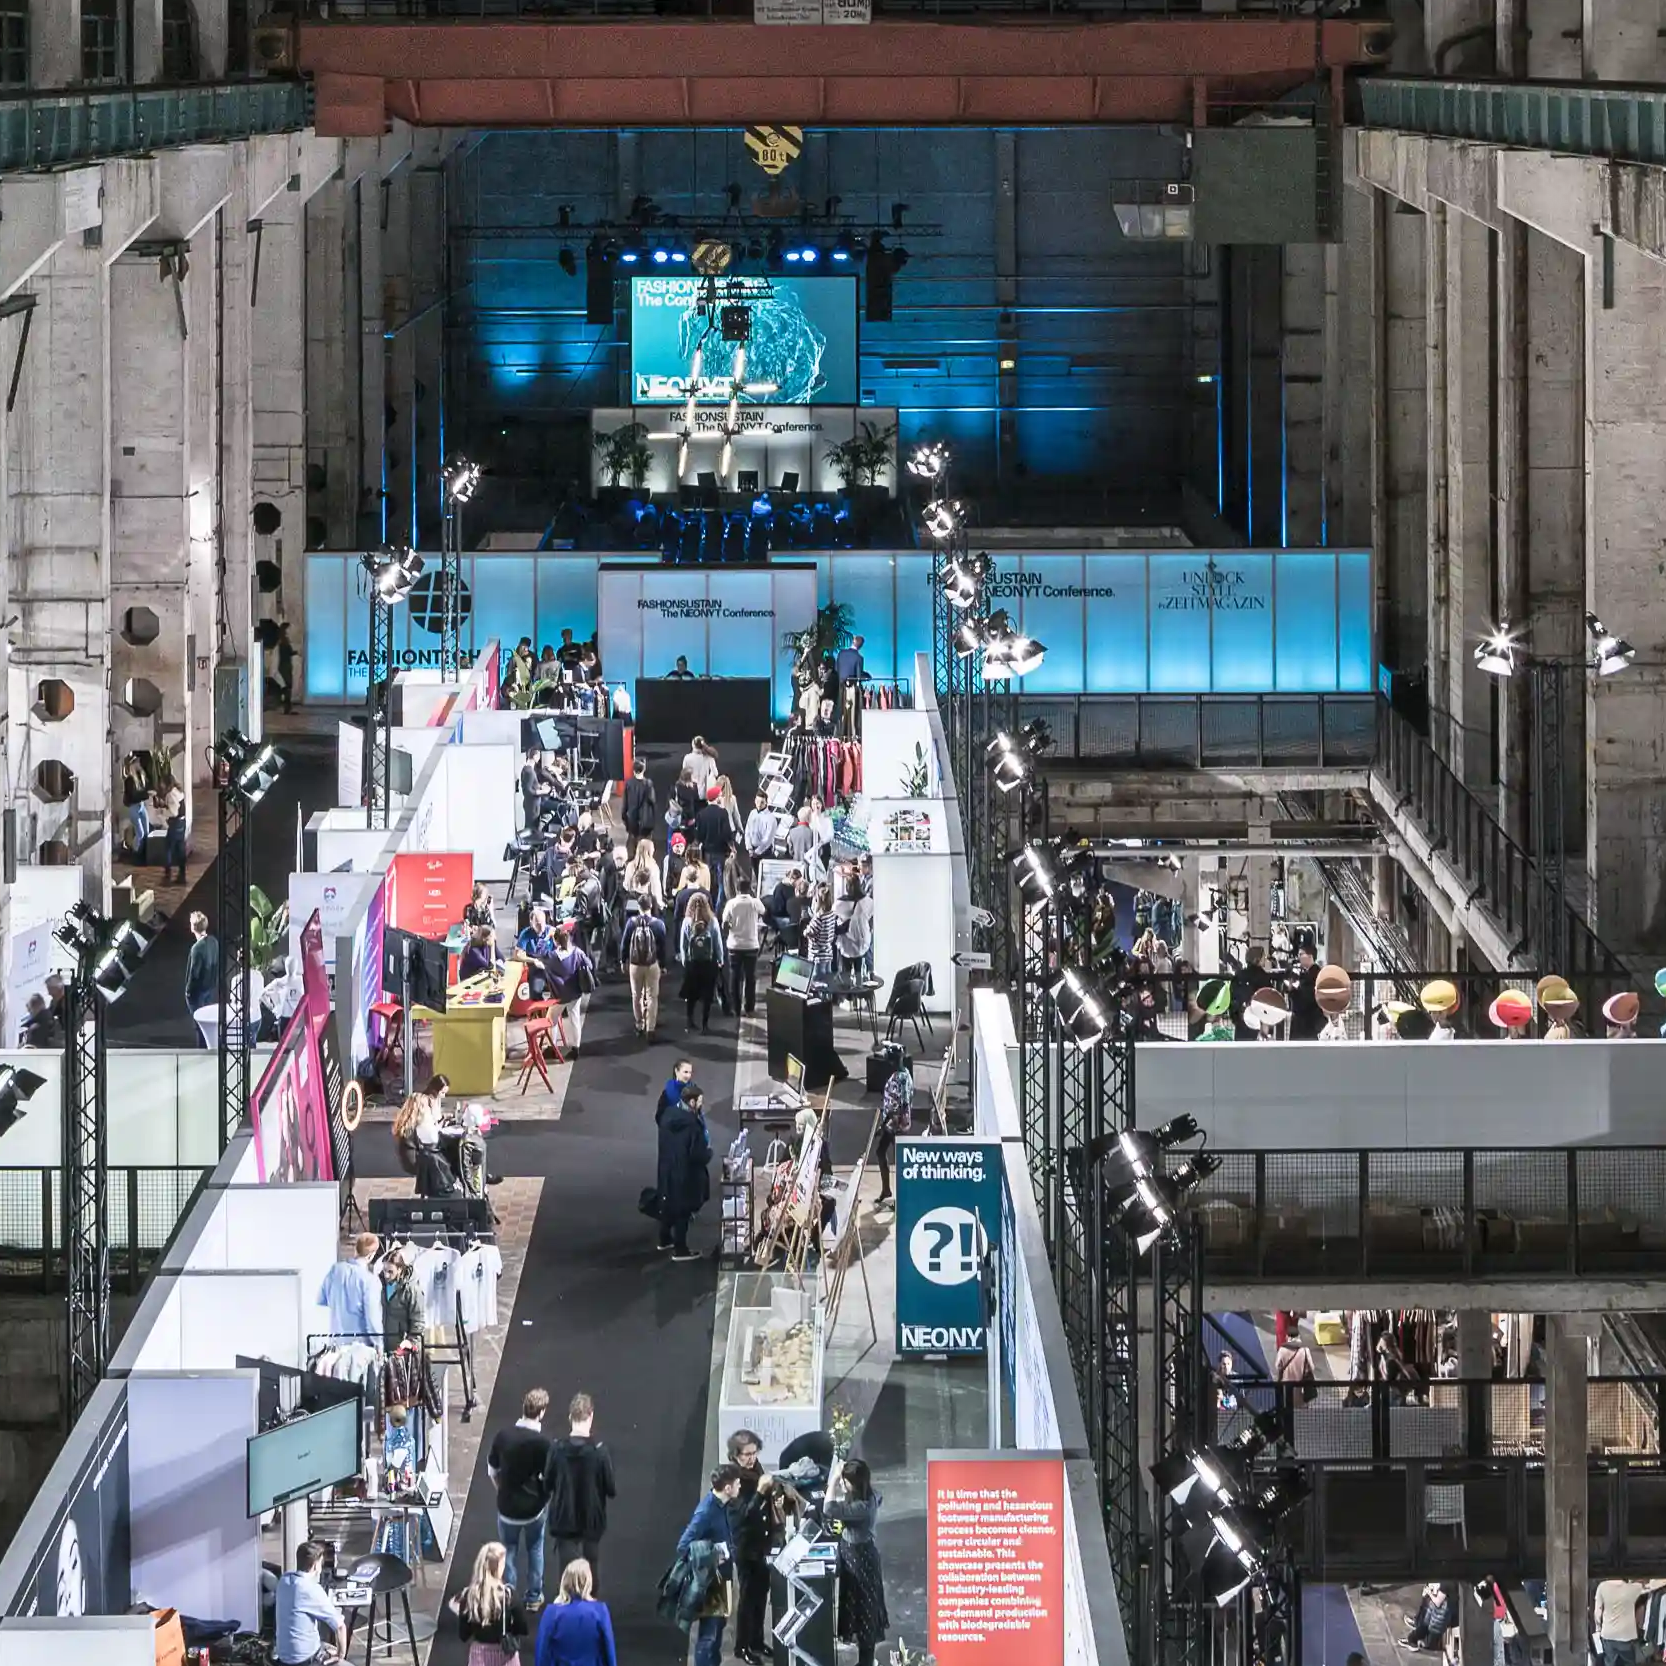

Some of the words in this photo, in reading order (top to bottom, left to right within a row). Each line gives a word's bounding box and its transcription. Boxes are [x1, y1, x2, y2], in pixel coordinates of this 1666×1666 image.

[1183, 572, 1245, 584] UNLOCK
[984, 585, 1041, 597] NEONYT
[1043, 585, 1115, 597] Conference.
[1192, 585, 1236, 596] STYLE
[638, 600, 721, 609] FASHIONSUSTAIN
[1165, 596, 1265, 610] ZEITMAGAZIN
[661, 608, 678, 618] The
[681, 608, 721, 618] NEONYT
[723, 608, 775, 618] Conference.
[903, 1148, 939, 1163] New
[943, 1150, 983, 1166] ways
[903, 1164, 919, 1179] of
[922, 1164, 986, 1182] thinking.
[938, 1489, 945, 1499] It
[947, 1489, 954, 1499] is
[956, 1489, 978, 1499] time
[980, 1489, 999, 1499] that
[1001, 1489, 1017, 1499] the
[938, 1501, 981, 1512] polluting
[983, 1501, 1001, 1512] and
[1004, 1501, 1053, 1512] hazardous
[938, 1513, 978, 1523] footwear
[981, 1513, 1048, 1523] manufacturing
[938, 1525, 973, 1536] process
[976, 1525, 1017, 1536] becomes
[1019, 1525, 1056, 1536] cleaner,
[938, 1537, 962, 1546] more
[965, 1537, 1001, 1546] circular
[1003, 1537, 1022, 1546] and
[938, 1549, 994, 1558] sustainable.
[997, 1549, 1016, 1558] This
[938, 1560, 982, 1571] showcase
[985, 1560, 1025, 1571] presents
[1028, 1560, 1043, 1571] the
[938, 1572, 999, 1582] collaboration
[1001, 1572, 1041, 1582] between
[946, 1584, 1024, 1595] industry-leading
[938, 1596, 989, 1606] companies
[991, 1596, 1041, 1606] combining
[938, 1608, 992, 1619] on-demand
[995, 1608, 1047, 1619] production
[938, 1620, 959, 1631] with
[961, 1620, 1030, 1631] biodegradable
[938, 1633, 985, 1642] resources.
